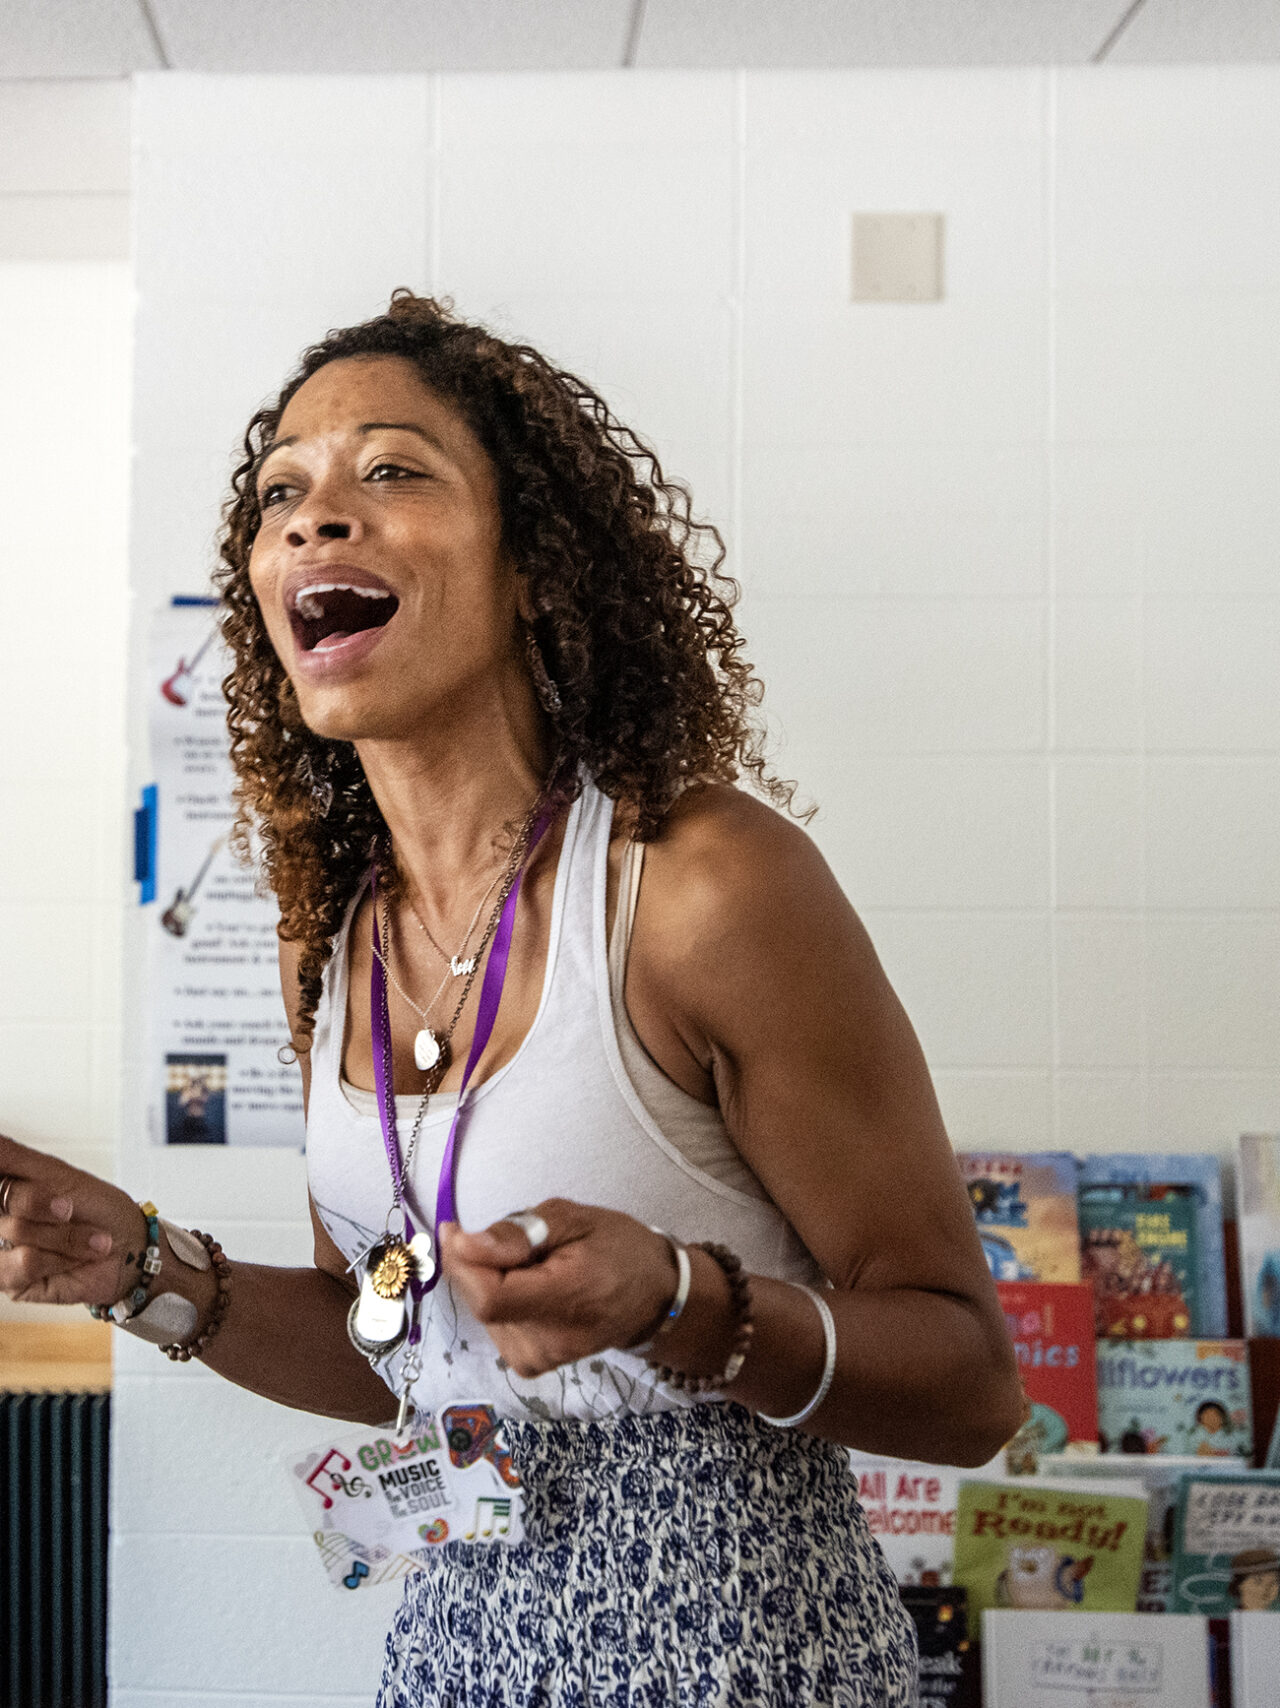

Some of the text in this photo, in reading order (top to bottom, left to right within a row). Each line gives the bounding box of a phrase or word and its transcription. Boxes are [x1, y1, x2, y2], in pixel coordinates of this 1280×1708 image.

[1013, 1338, 1080, 1369] nics
[378, 1459, 440, 1491] MUSIC
[399, 1476, 446, 1500] VOICE
[858, 1471, 942, 1502] All Are
[407, 1491, 452, 1514] SOUL
[866, 1503, 957, 1535] elcome
[972, 1508, 1129, 1552] Ready!
